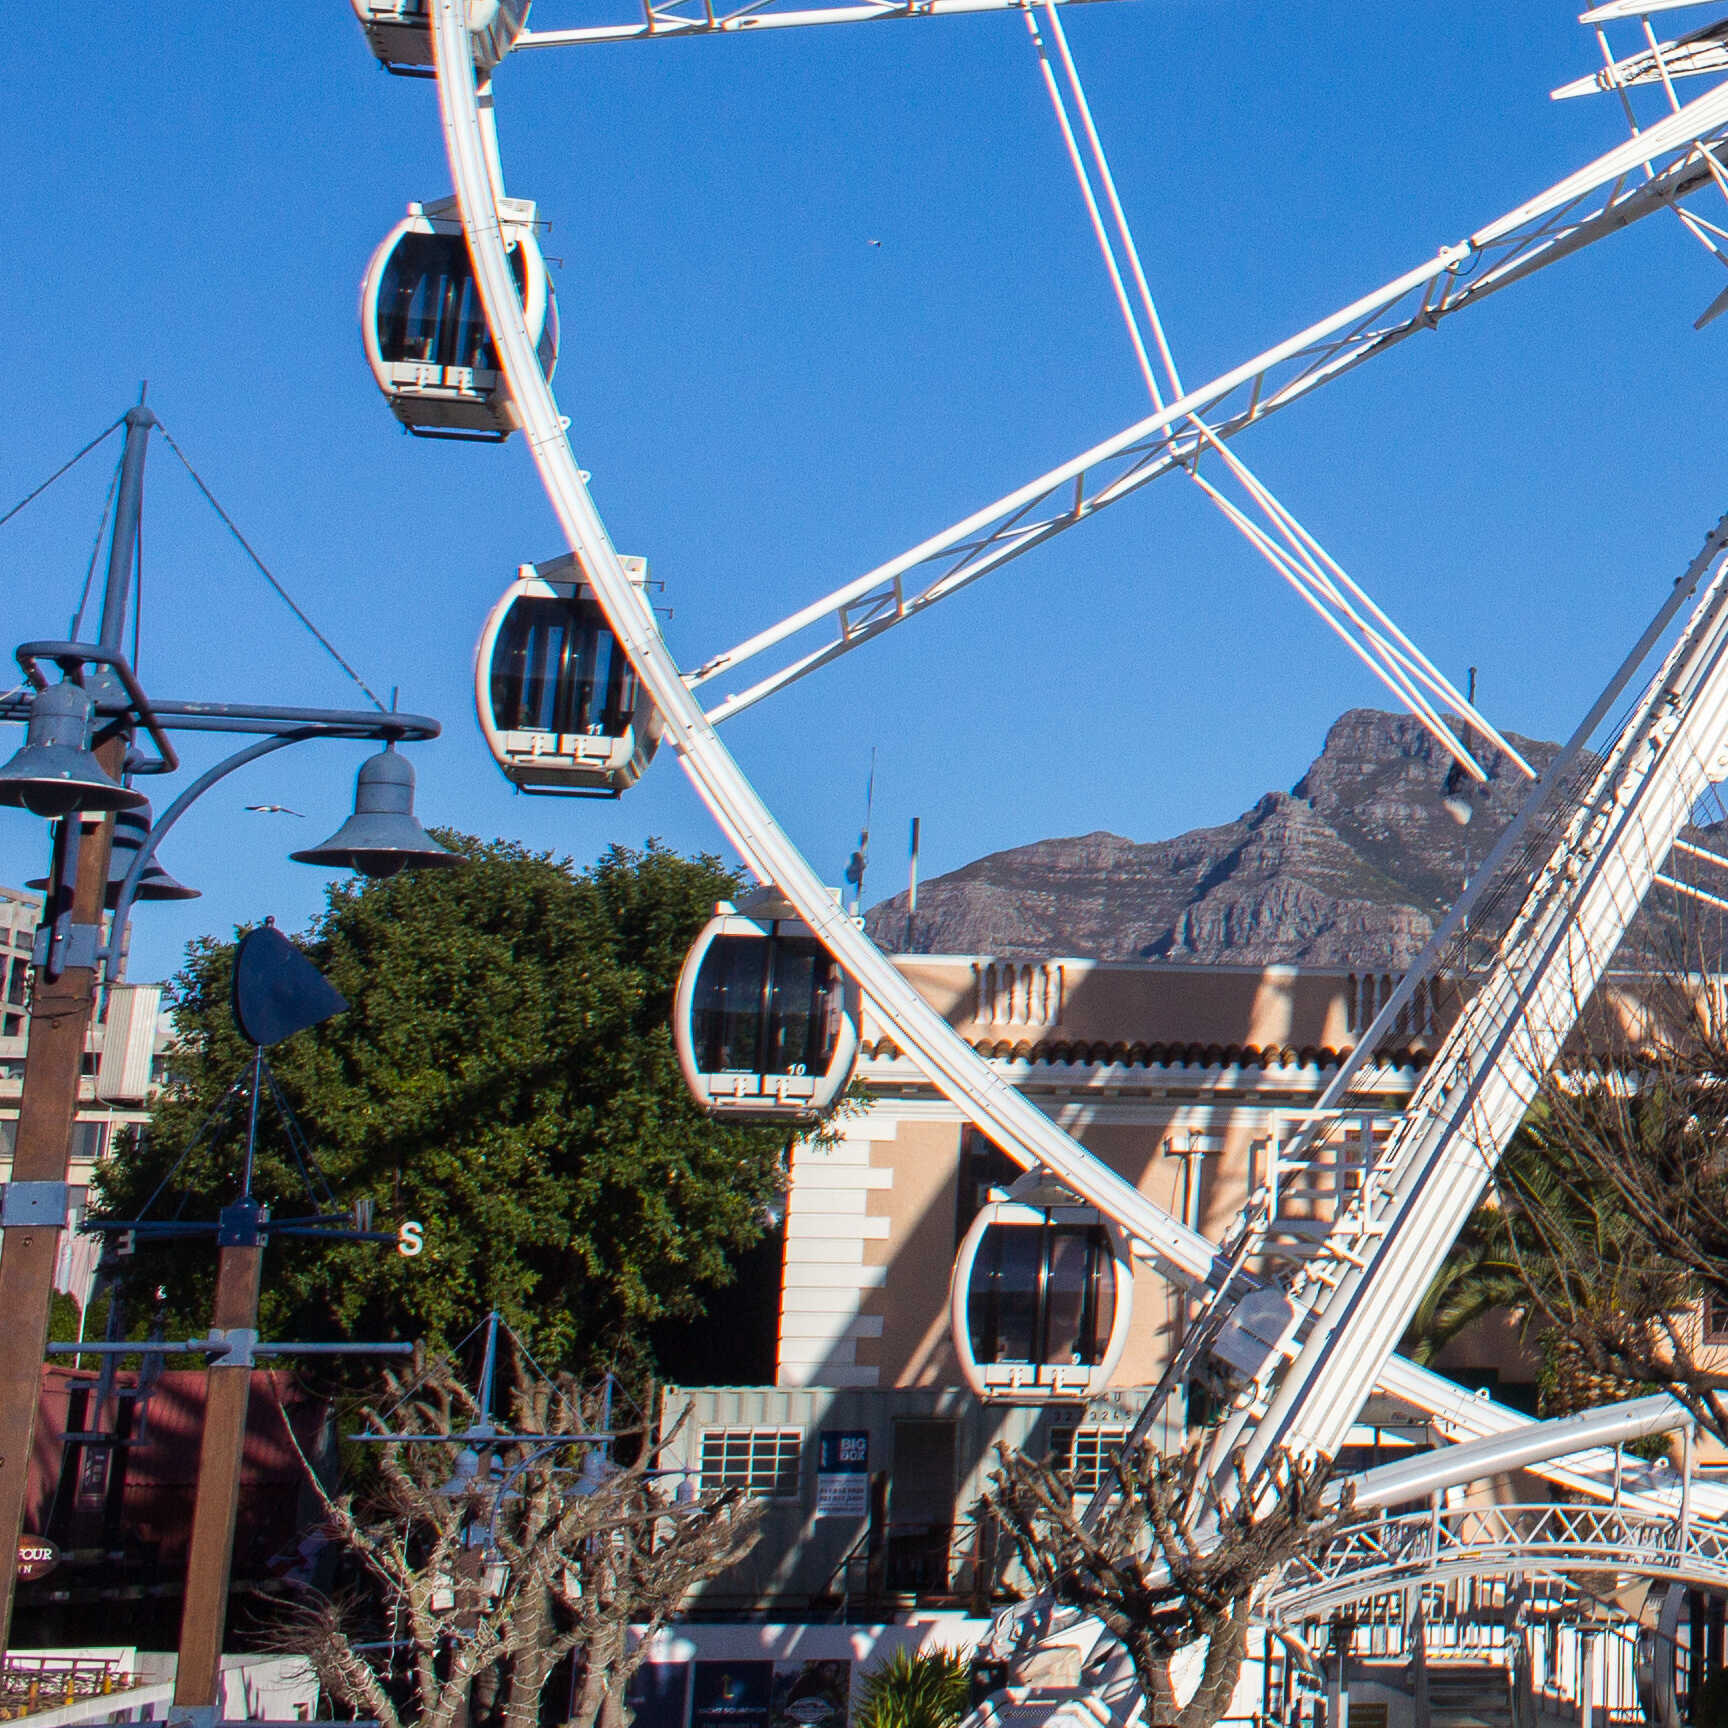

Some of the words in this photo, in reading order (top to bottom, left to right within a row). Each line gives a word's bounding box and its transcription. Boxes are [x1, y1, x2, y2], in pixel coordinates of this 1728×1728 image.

[586, 723, 604, 735] 11
[786, 1063, 807, 1076] 10
[398, 1221, 424, 1257] S
[1071, 1352, 1082, 1365] 9
[841, 1438, 867, 1449] BIG
